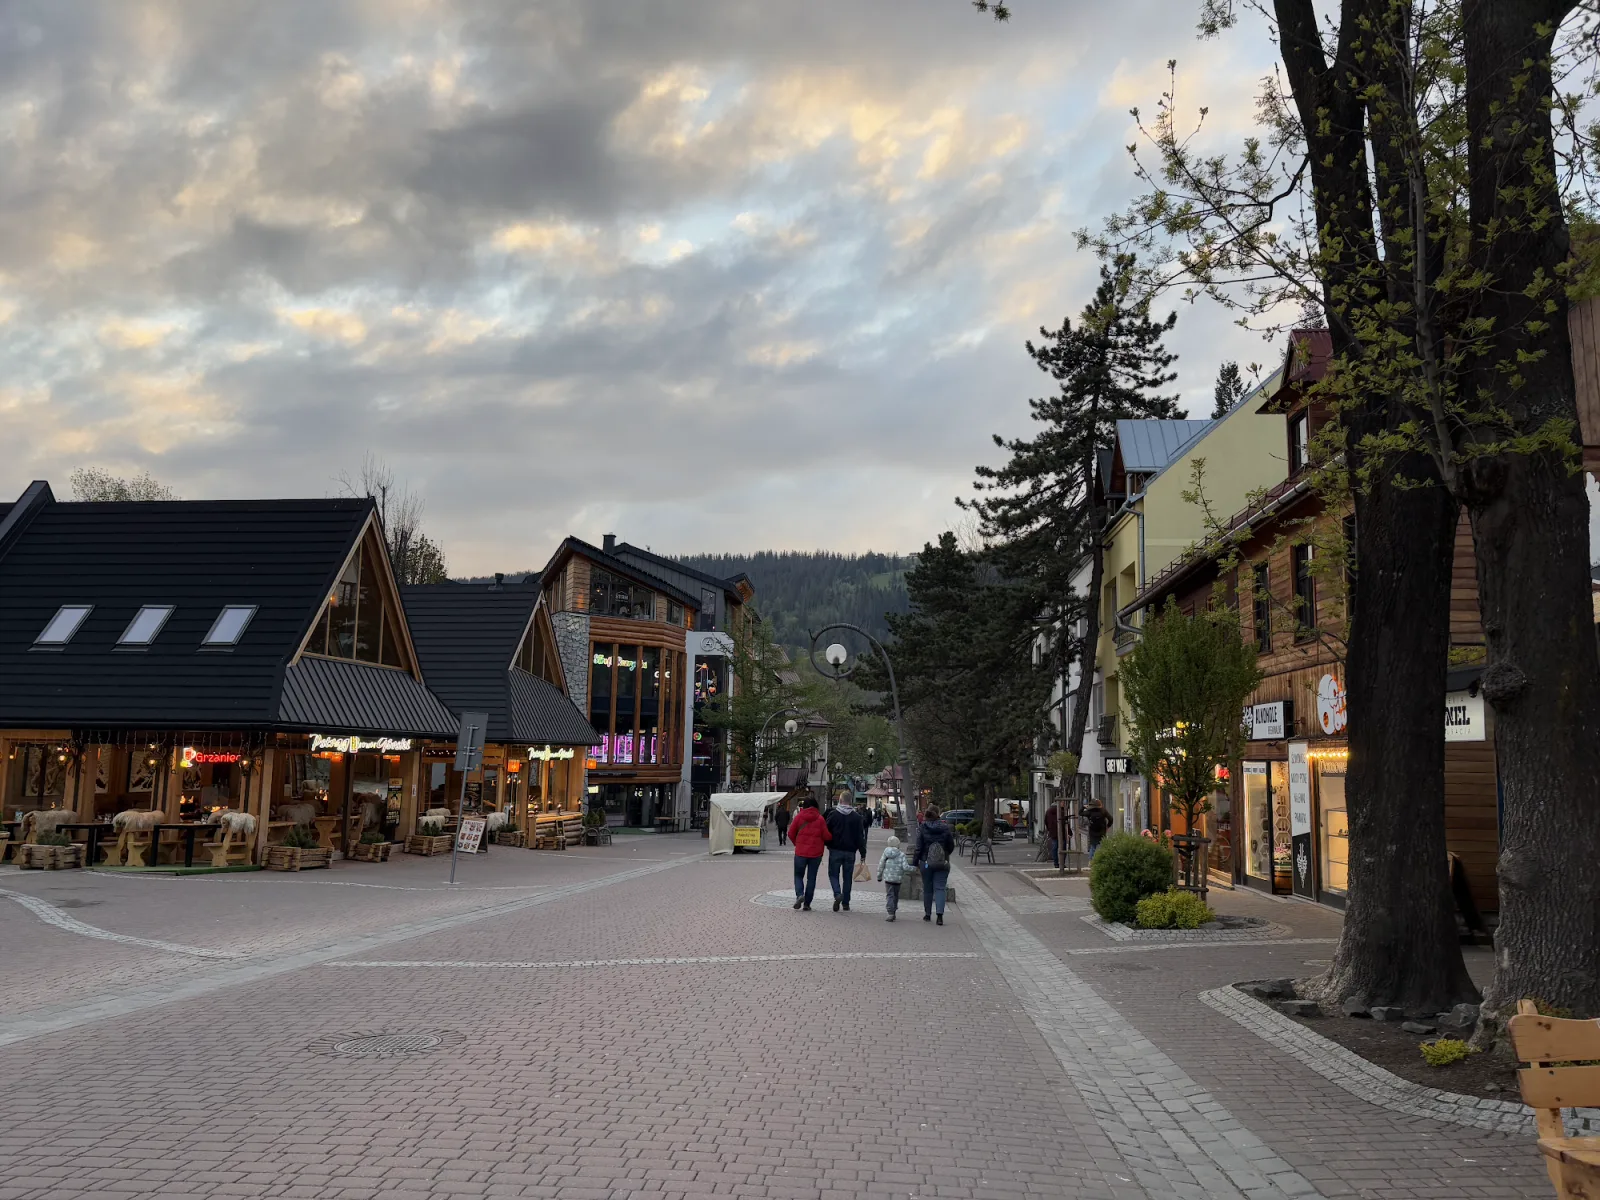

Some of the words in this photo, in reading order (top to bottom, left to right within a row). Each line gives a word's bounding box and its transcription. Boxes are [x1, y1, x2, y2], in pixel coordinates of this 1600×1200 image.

[617, 656, 648, 671] Rozryki
[1255, 706, 1278, 724] ALKOHOLE
[1445, 705, 1471, 726] NEL
